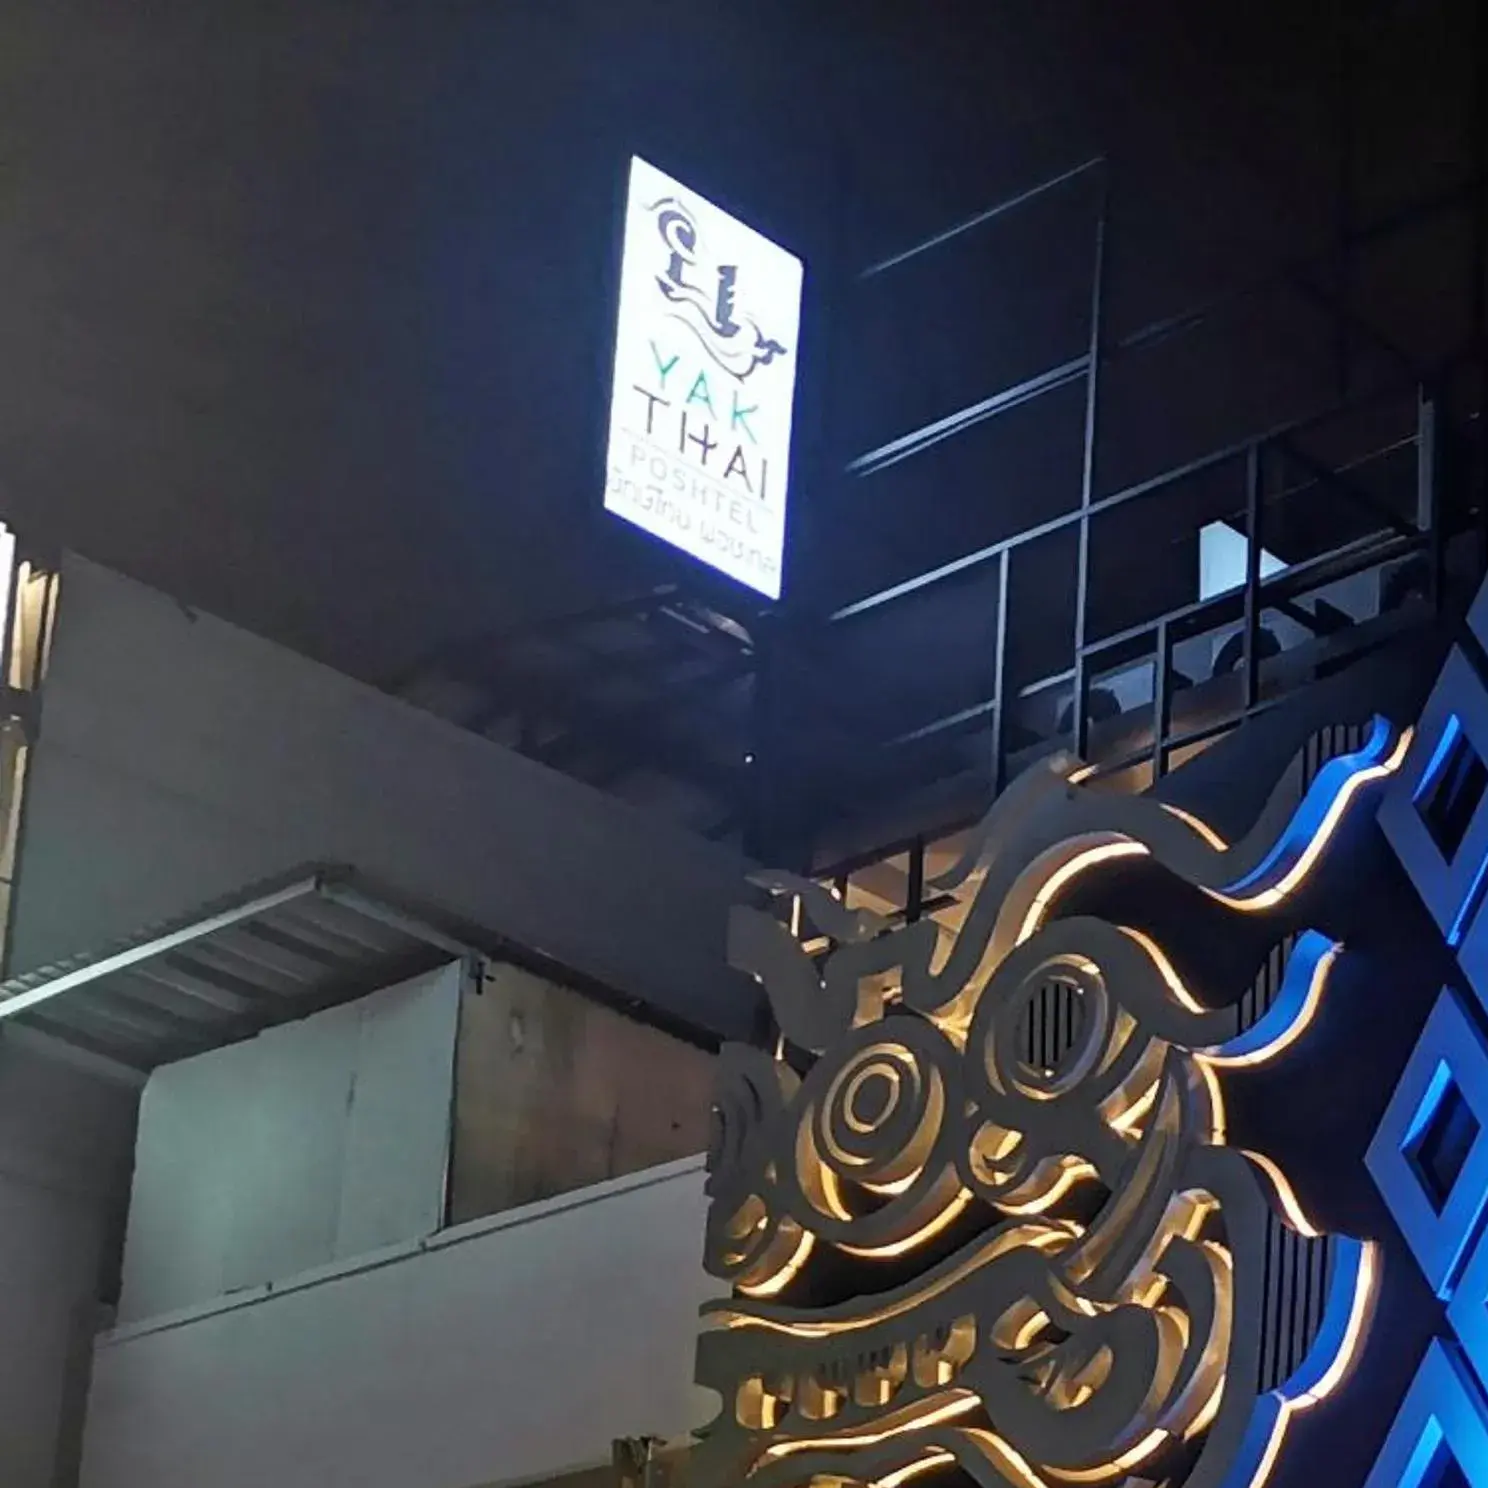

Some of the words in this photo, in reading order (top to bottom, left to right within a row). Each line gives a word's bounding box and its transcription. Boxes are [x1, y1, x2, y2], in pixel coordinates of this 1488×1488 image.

[632, 384, 768, 501] THAI
[649, 339, 759, 445] YAK
[629, 444, 760, 535] POSHTEL
